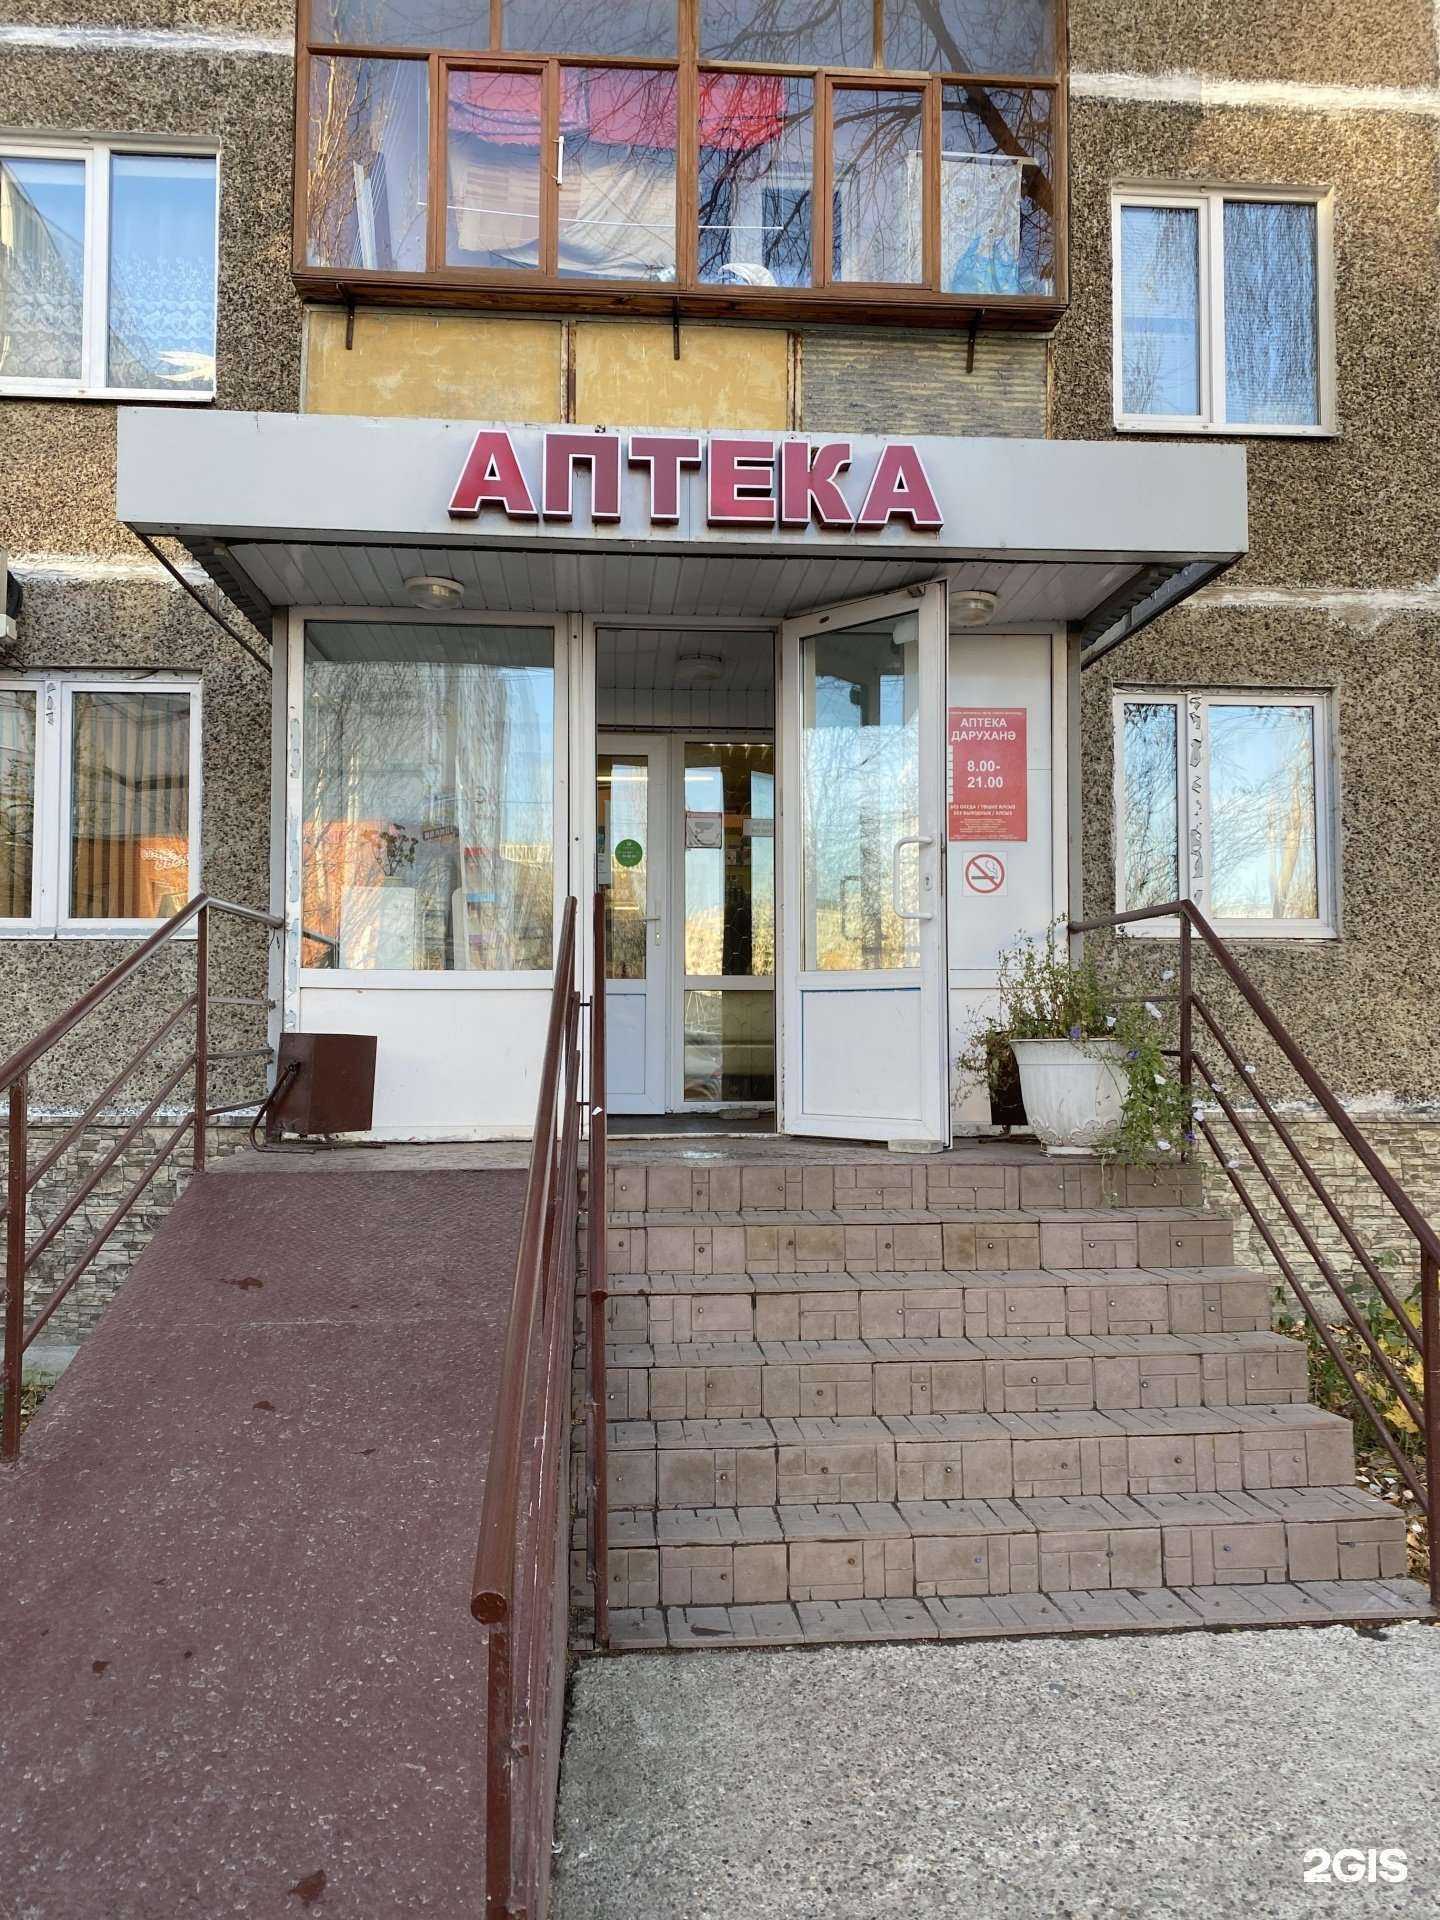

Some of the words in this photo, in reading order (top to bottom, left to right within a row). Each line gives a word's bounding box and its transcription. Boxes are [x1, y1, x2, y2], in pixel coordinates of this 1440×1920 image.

[447, 429, 944, 531] АПТЕКА
[960, 717, 1008, 728] АПТЕКА
[951, 730, 1017, 742] ДАРУХАНӘ
[967, 760, 1001, 772] 8.00-
[967, 776, 1004, 788] 21.00
